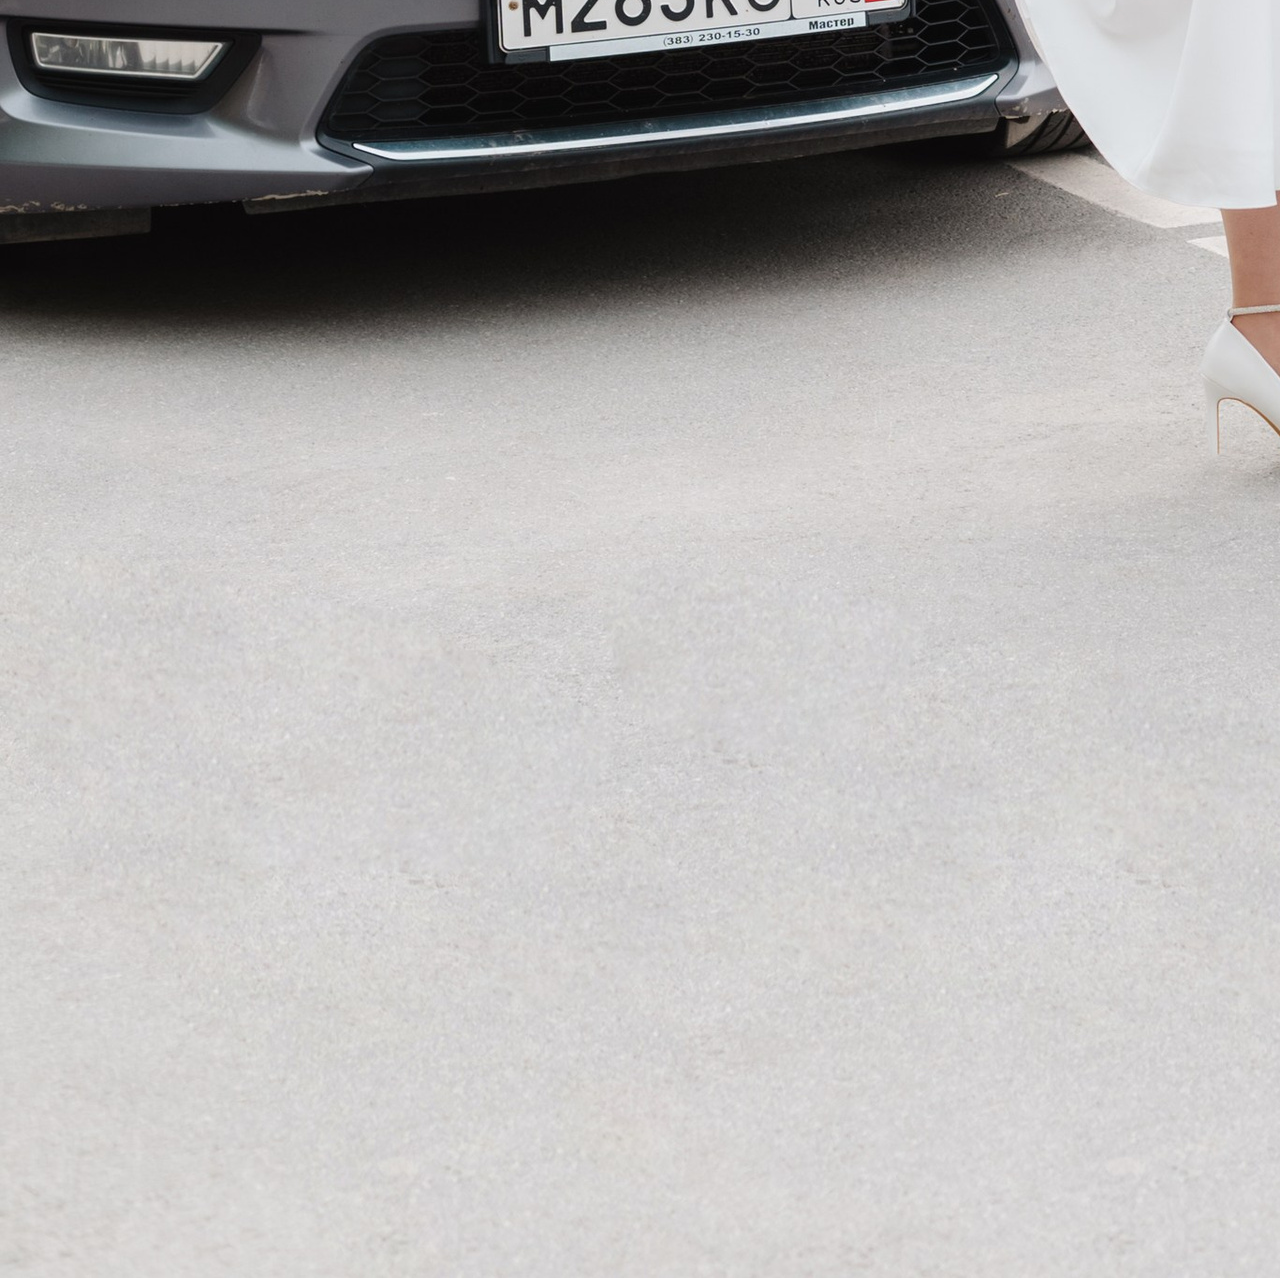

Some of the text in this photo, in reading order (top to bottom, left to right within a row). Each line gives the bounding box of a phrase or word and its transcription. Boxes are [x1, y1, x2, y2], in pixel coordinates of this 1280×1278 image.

[808, 17, 854, 31] Мастер
[663, 27, 760, 47] (383) 230-15-30
